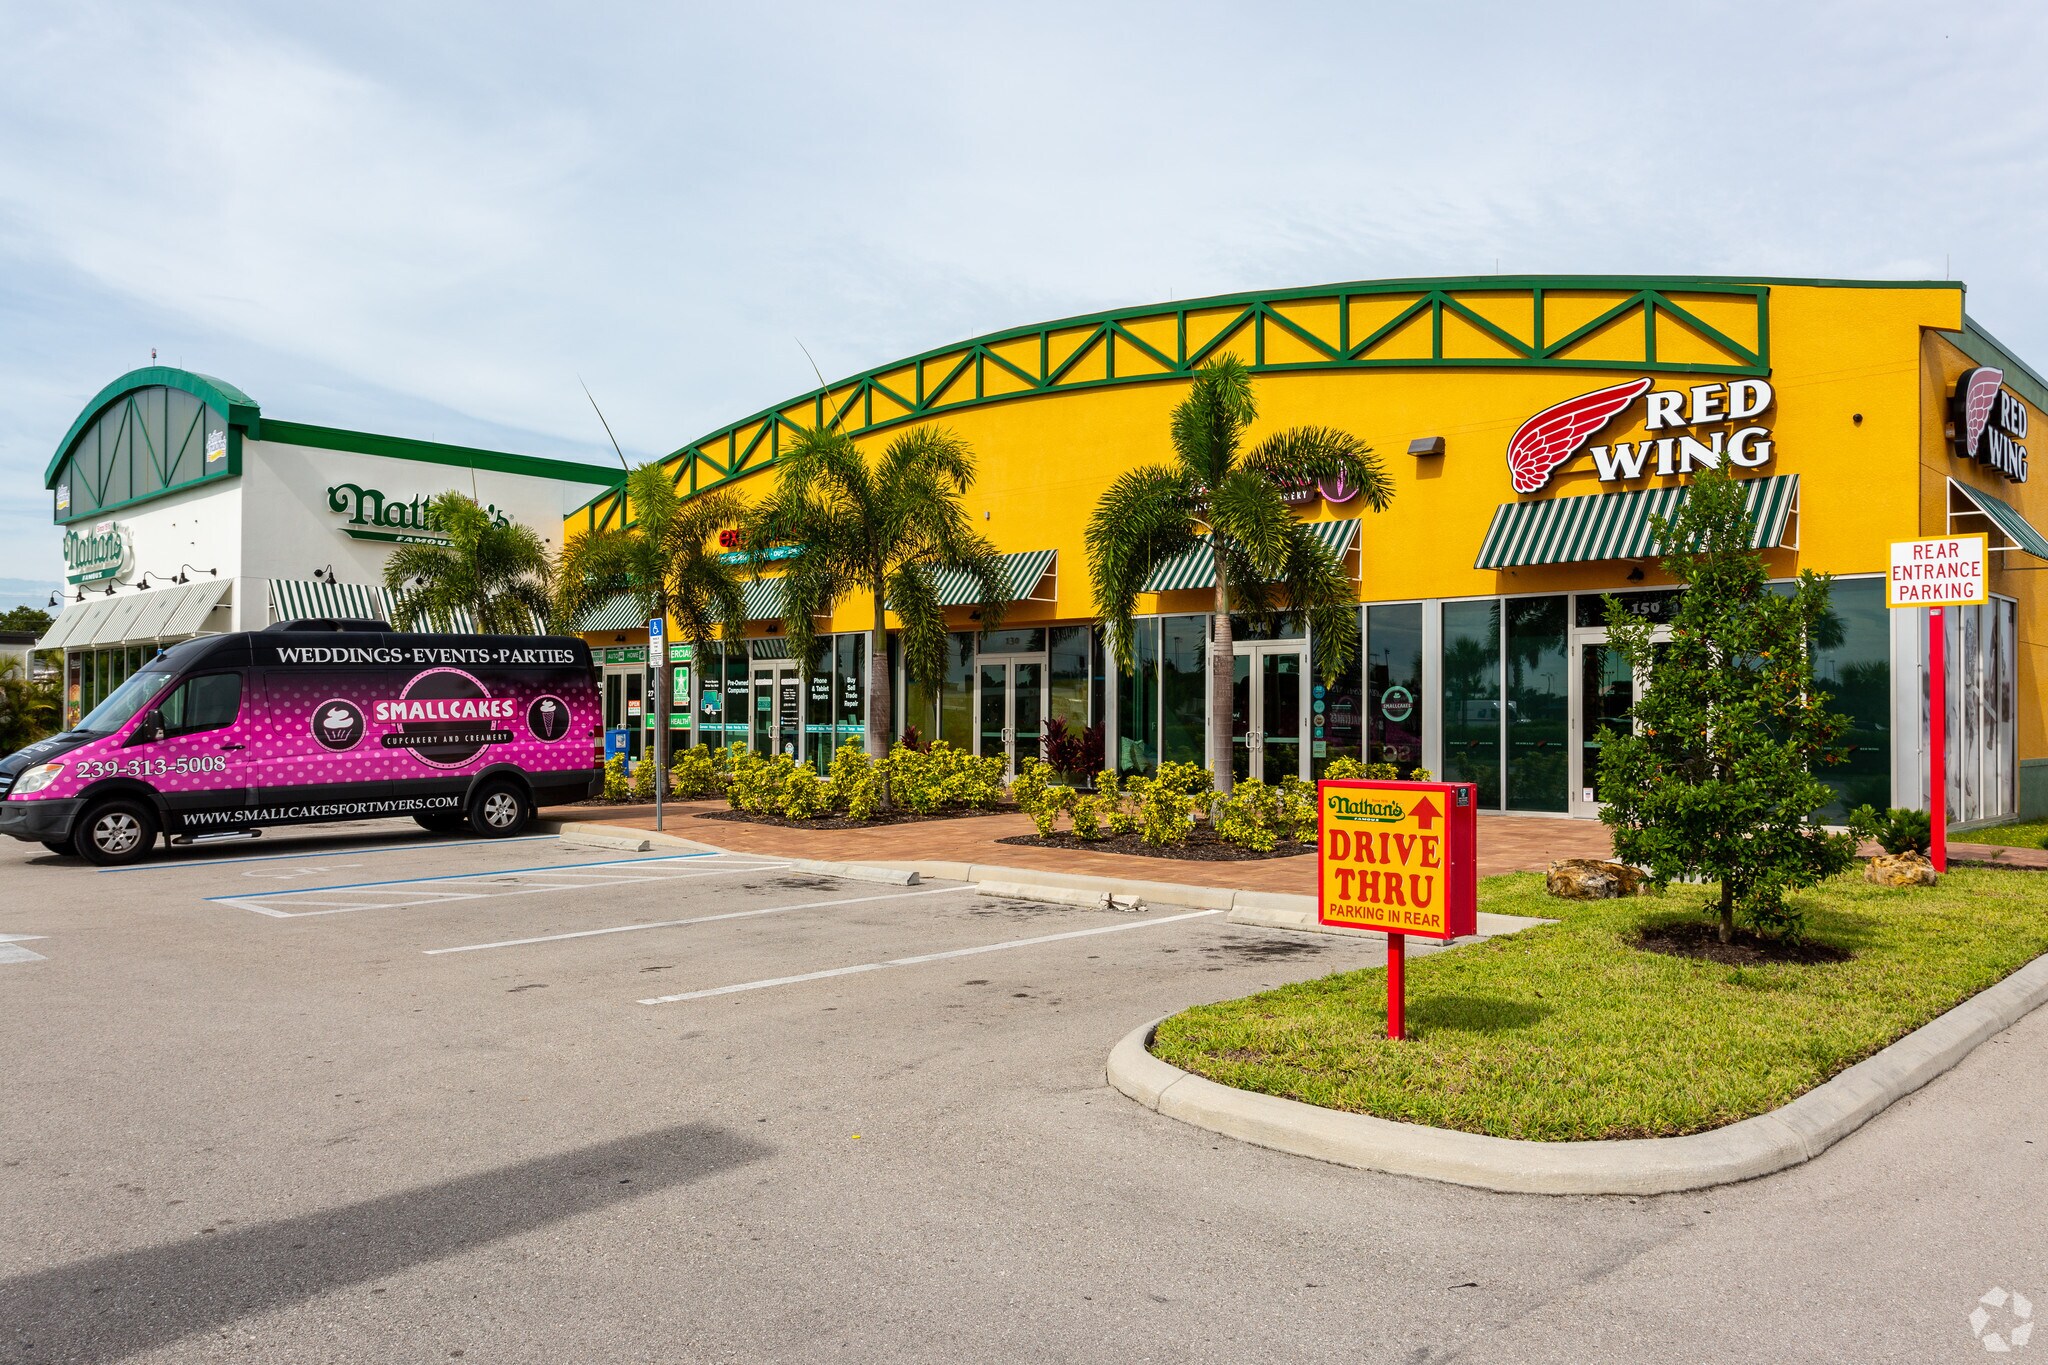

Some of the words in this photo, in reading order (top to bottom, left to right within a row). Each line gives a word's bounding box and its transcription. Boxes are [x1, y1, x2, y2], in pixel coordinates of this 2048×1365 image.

[1645, 379, 1772, 430] RED
[2000, 389, 2028, 439] RED
[1590, 426, 1772, 482] WING
[1988, 425, 2028, 483] WING
[63, 521, 122, 570] Nathan's
[1913, 542, 1958, 560] REAR
[82, 571, 102, 581] FAMOUS
[1892, 561, 1981, 580] ENTRANCE
[1900, 582, 1974, 601] PARKING
[1632, 602, 1660, 614] 150
[1005, 636, 1020, 646] 130
[276, 647, 402, 664] WEDDINGS
[414, 648, 490, 663] EVENTS
[500, 650, 574, 664] PARTIES
[376, 700, 514, 721] SMALLCAKES
[1383, 702, 1412, 710] SMALLCAKES
[386, 736, 438, 745] CUPCAKERY
[443, 735, 460, 743] AND
[464, 733, 508, 742] CREAMERY
[76, 756, 226, 778] 239-313-5008
[183, 796, 459, 826] WWW.SMALLCAKESFORTMYERS.COM
[1328, 796, 1404, 817] Nathan's
[1328, 829, 1441, 869] DRIVE
[1335, 868, 1434, 908] THRU
[1330, 904, 1384, 920] PARKING
[1388, 910, 1400, 922] IN
[1404, 912, 1440, 928] REAR
